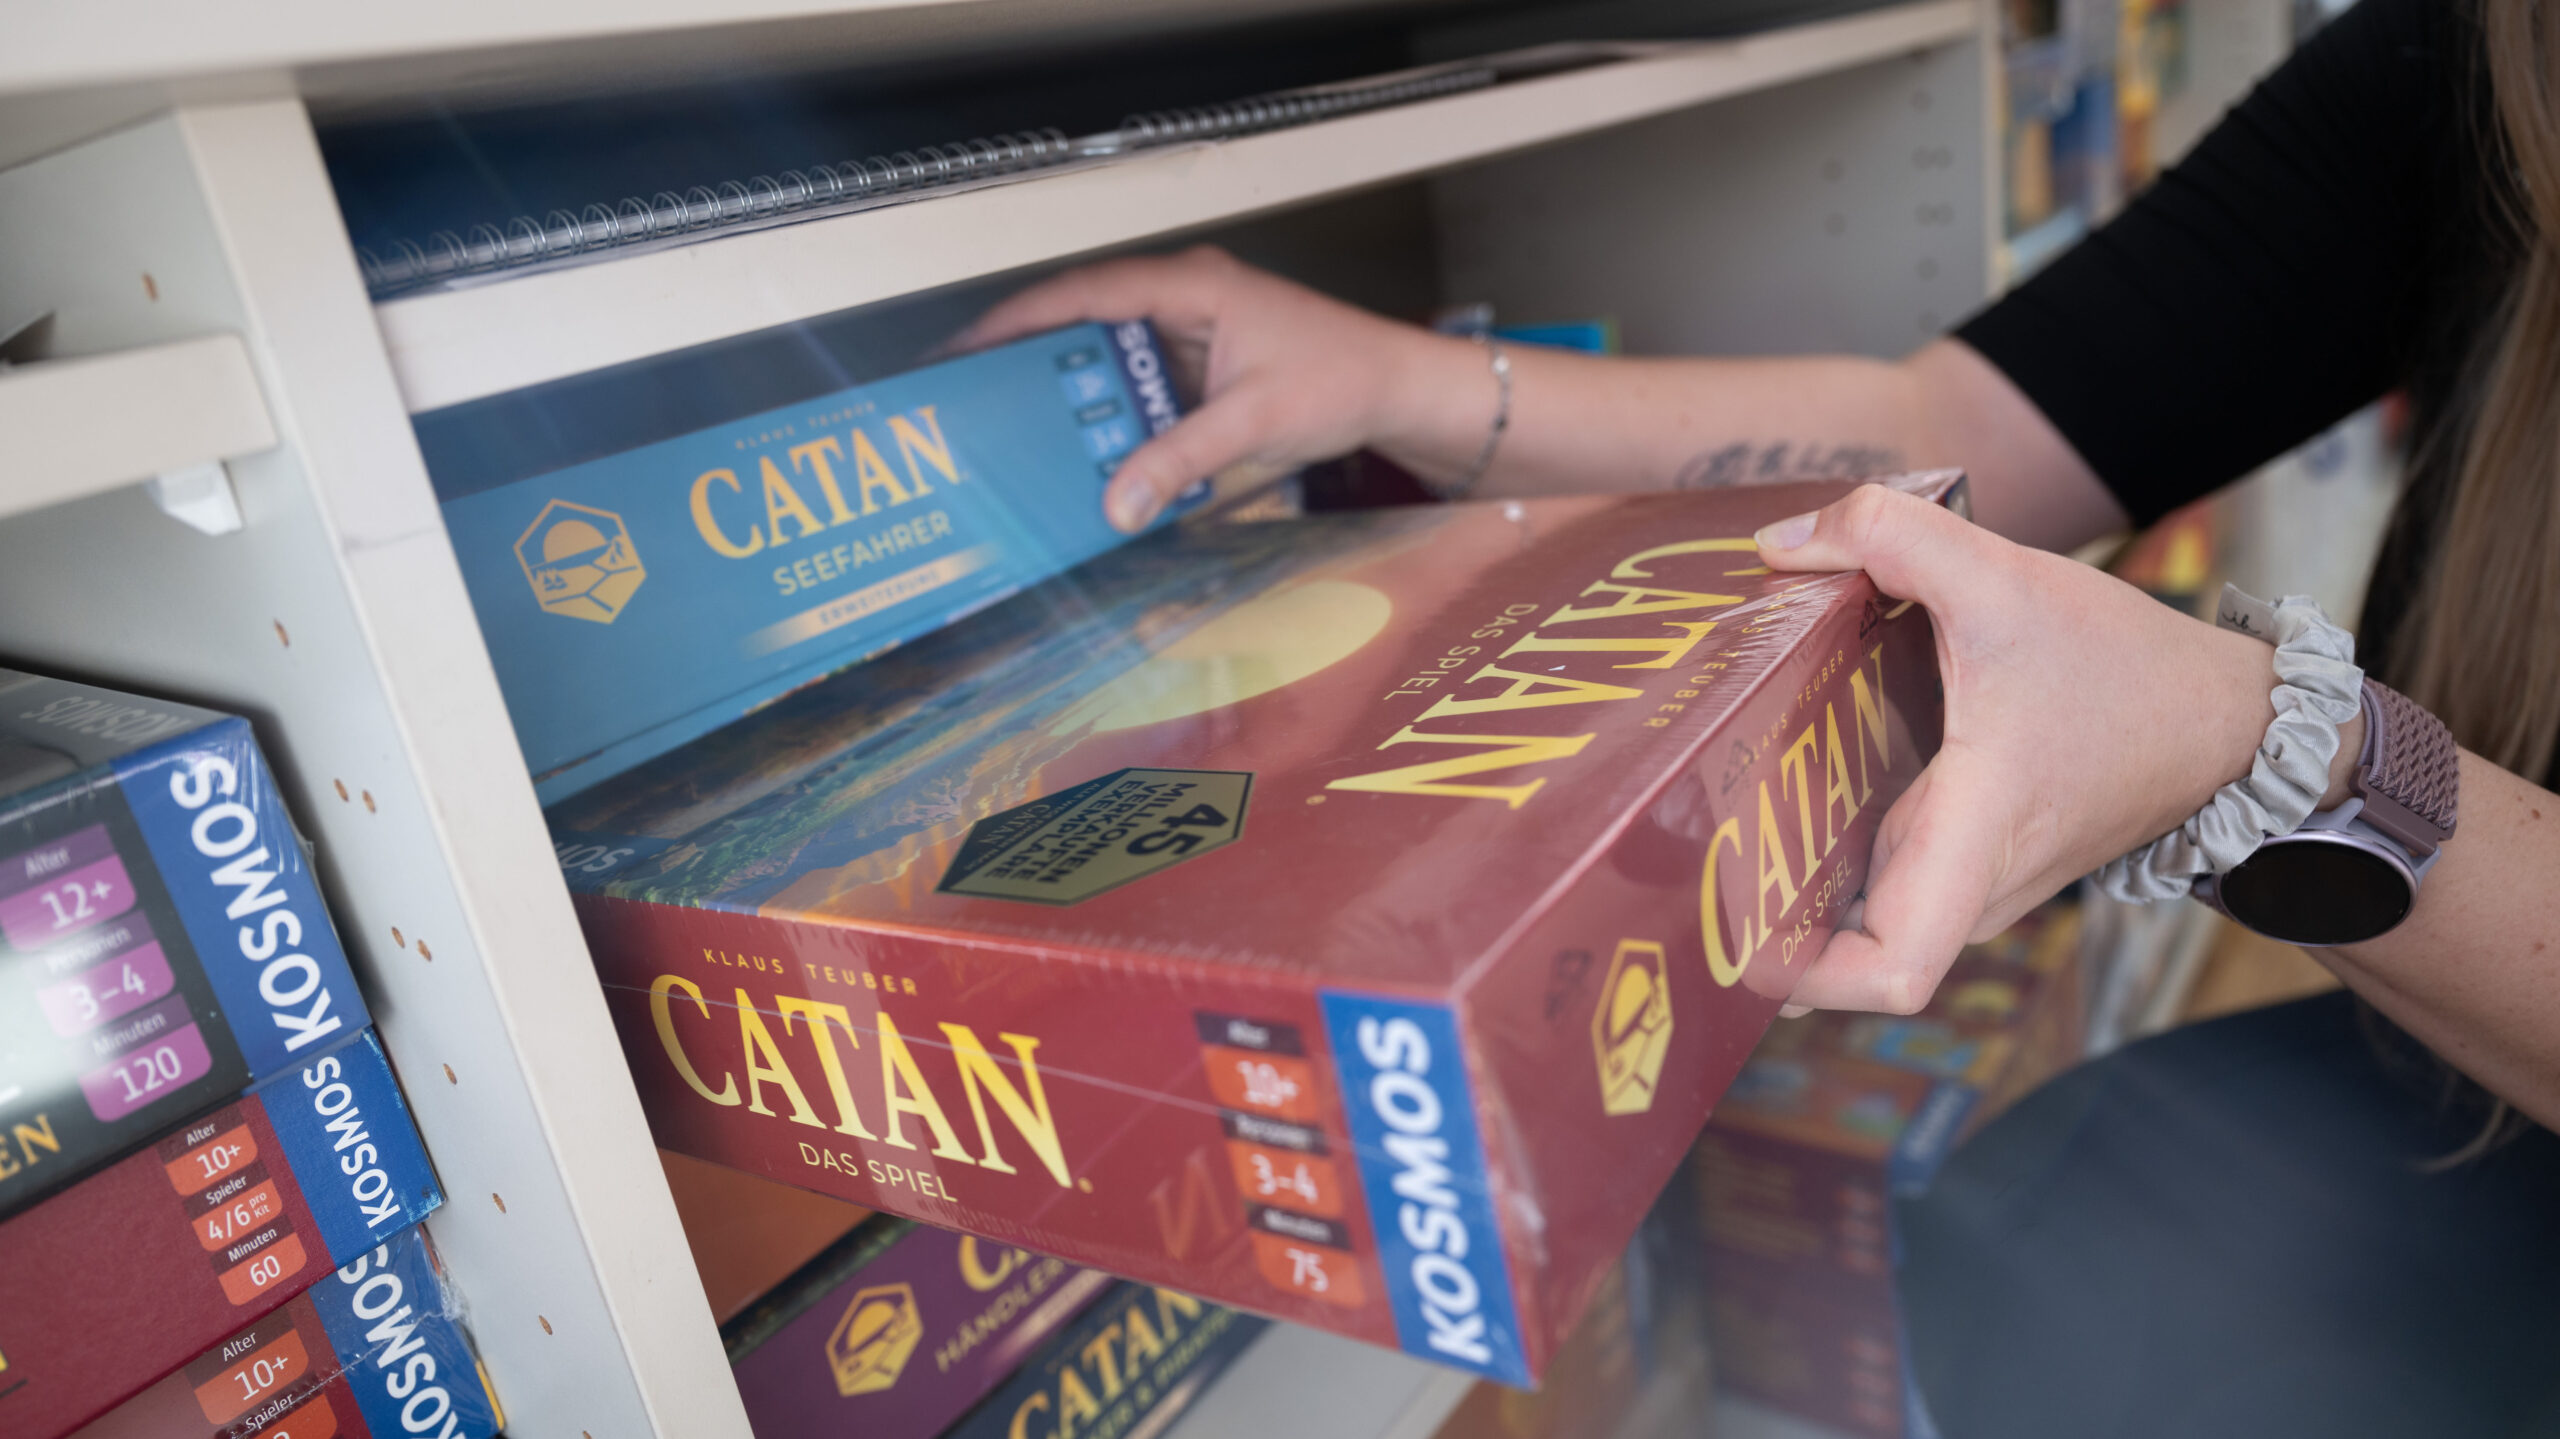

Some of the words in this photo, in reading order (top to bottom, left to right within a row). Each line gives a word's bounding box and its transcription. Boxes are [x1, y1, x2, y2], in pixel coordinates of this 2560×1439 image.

[690, 404, 960, 559] CATAN
[773, 509, 952, 596] SEEFAHRER
[1471, 603, 1539, 639] DAS
[1325, 538, 1770, 810] CATAN
[1383, 645, 1481, 701] SPIEL
[1642, 649, 1740, 728] TEUBER
[1797, 649, 1844, 709] TEUBER
[984, 780, 1146, 879] EXEMPLARE
[1009, 783, 1169, 880] VERKAUFTE
[1037, 783, 1198, 883] MILLIONEN
[1126, 803, 1228, 856] 45
[1700, 641, 1891, 988] CATAN
[40, 880, 113, 930] 12+
[170, 754, 342, 1053] KOSMOS
[1782, 909, 1812, 966] DAS
[1815, 855, 1852, 918] SPIEL
[703, 948, 784, 974] KLAUS
[805, 963, 918, 996] TEUBER
[113, 1046, 182, 1103] 120
[650, 974, 1073, 1189] CATAN
[186, 1123, 216, 1147] Alter
[196, 1144, 241, 1179] 10+
[303, 1056, 400, 1229] KOSMOS
[206, 1174, 248, 1206] Spieler
[249, 1191, 268, 1210] pro
[798, 1142, 859, 1177] DAS
[867, 1159, 958, 1203] SPIEL
[1357, 1014, 1492, 1366] KOSMOS
[208, 1203, 250, 1240] 4/6
[253, 1203, 270, 1220] Kit
[228, 1227, 278, 1263] Minuten
[249, 1255, 281, 1287] 60
[1285, 1246, 1329, 1293] 75
[222, 1331, 258, 1362] Alter
[234, 1355, 289, 1401] 10+
[245, 1392, 296, 1432] Spieler
